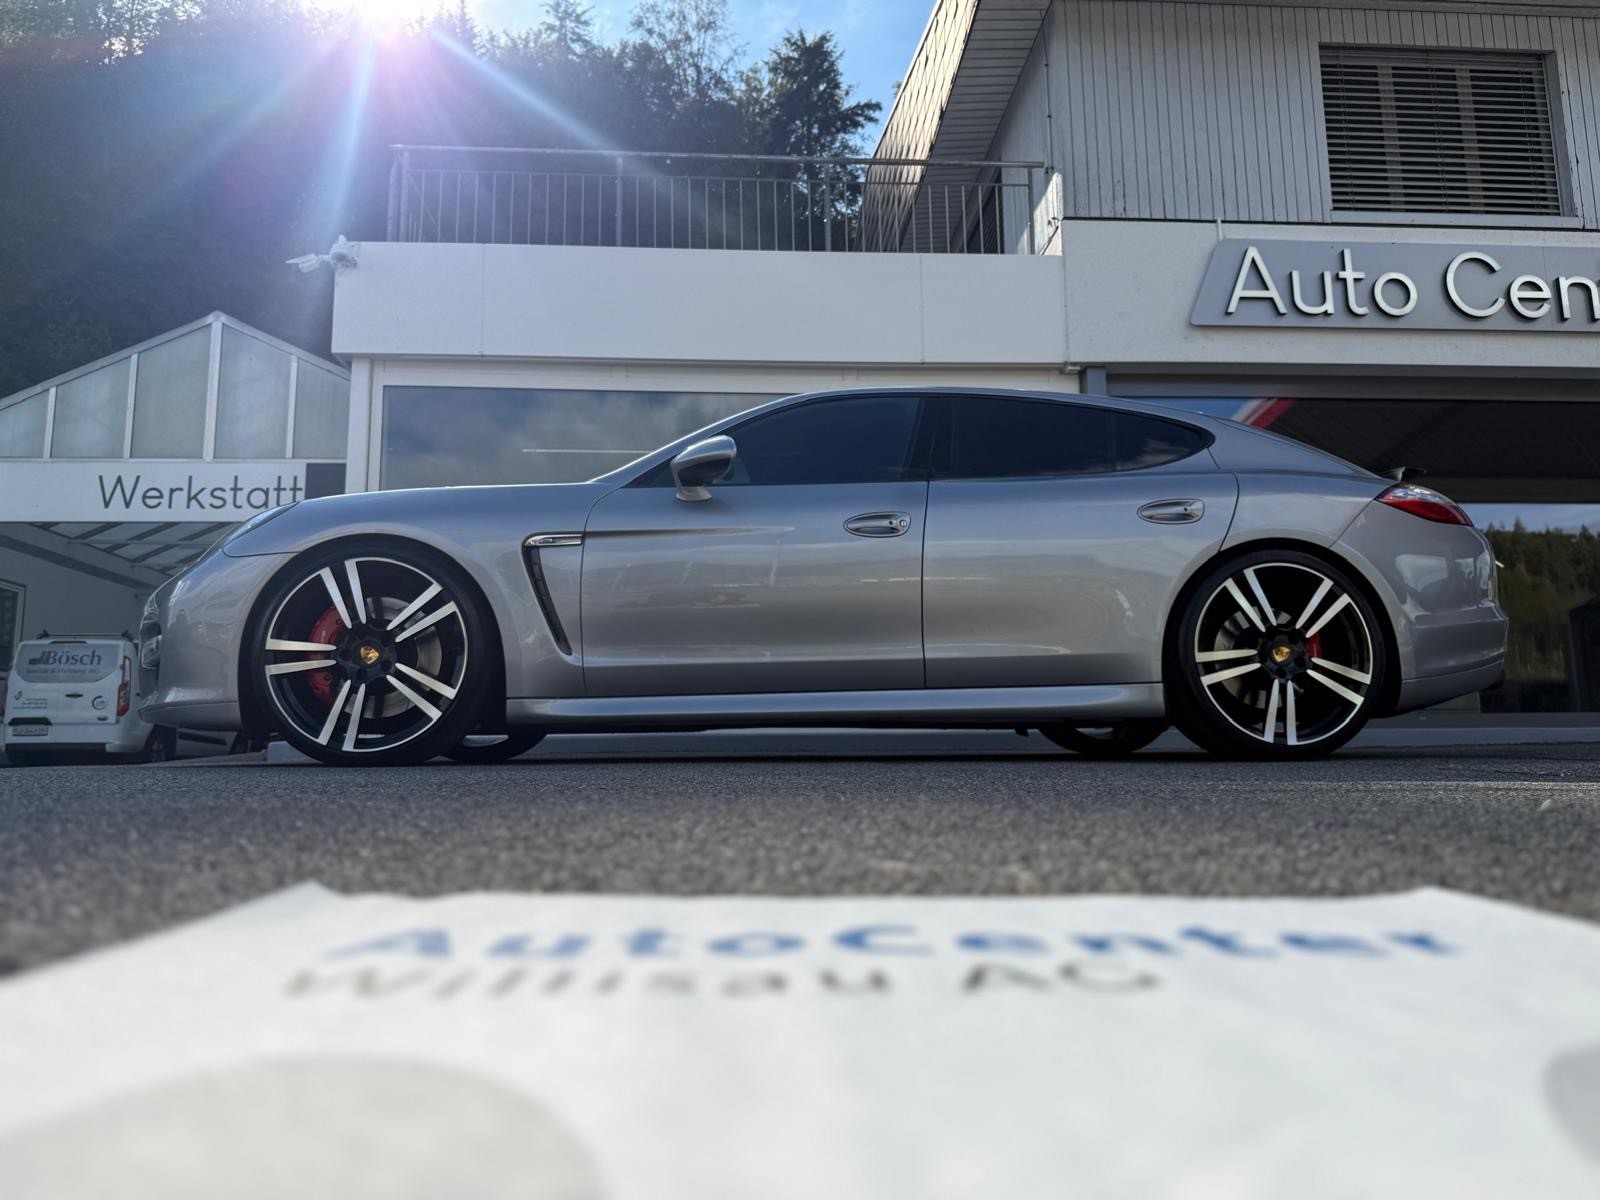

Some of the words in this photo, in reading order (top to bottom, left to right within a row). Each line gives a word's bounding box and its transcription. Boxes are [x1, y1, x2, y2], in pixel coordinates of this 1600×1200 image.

[1226, 246, 1418, 317] Auto
[1444, 251, 1600, 321] Cen
[98, 475, 303, 510] Werkstatt
[46, 649, 102, 666] Bösch
